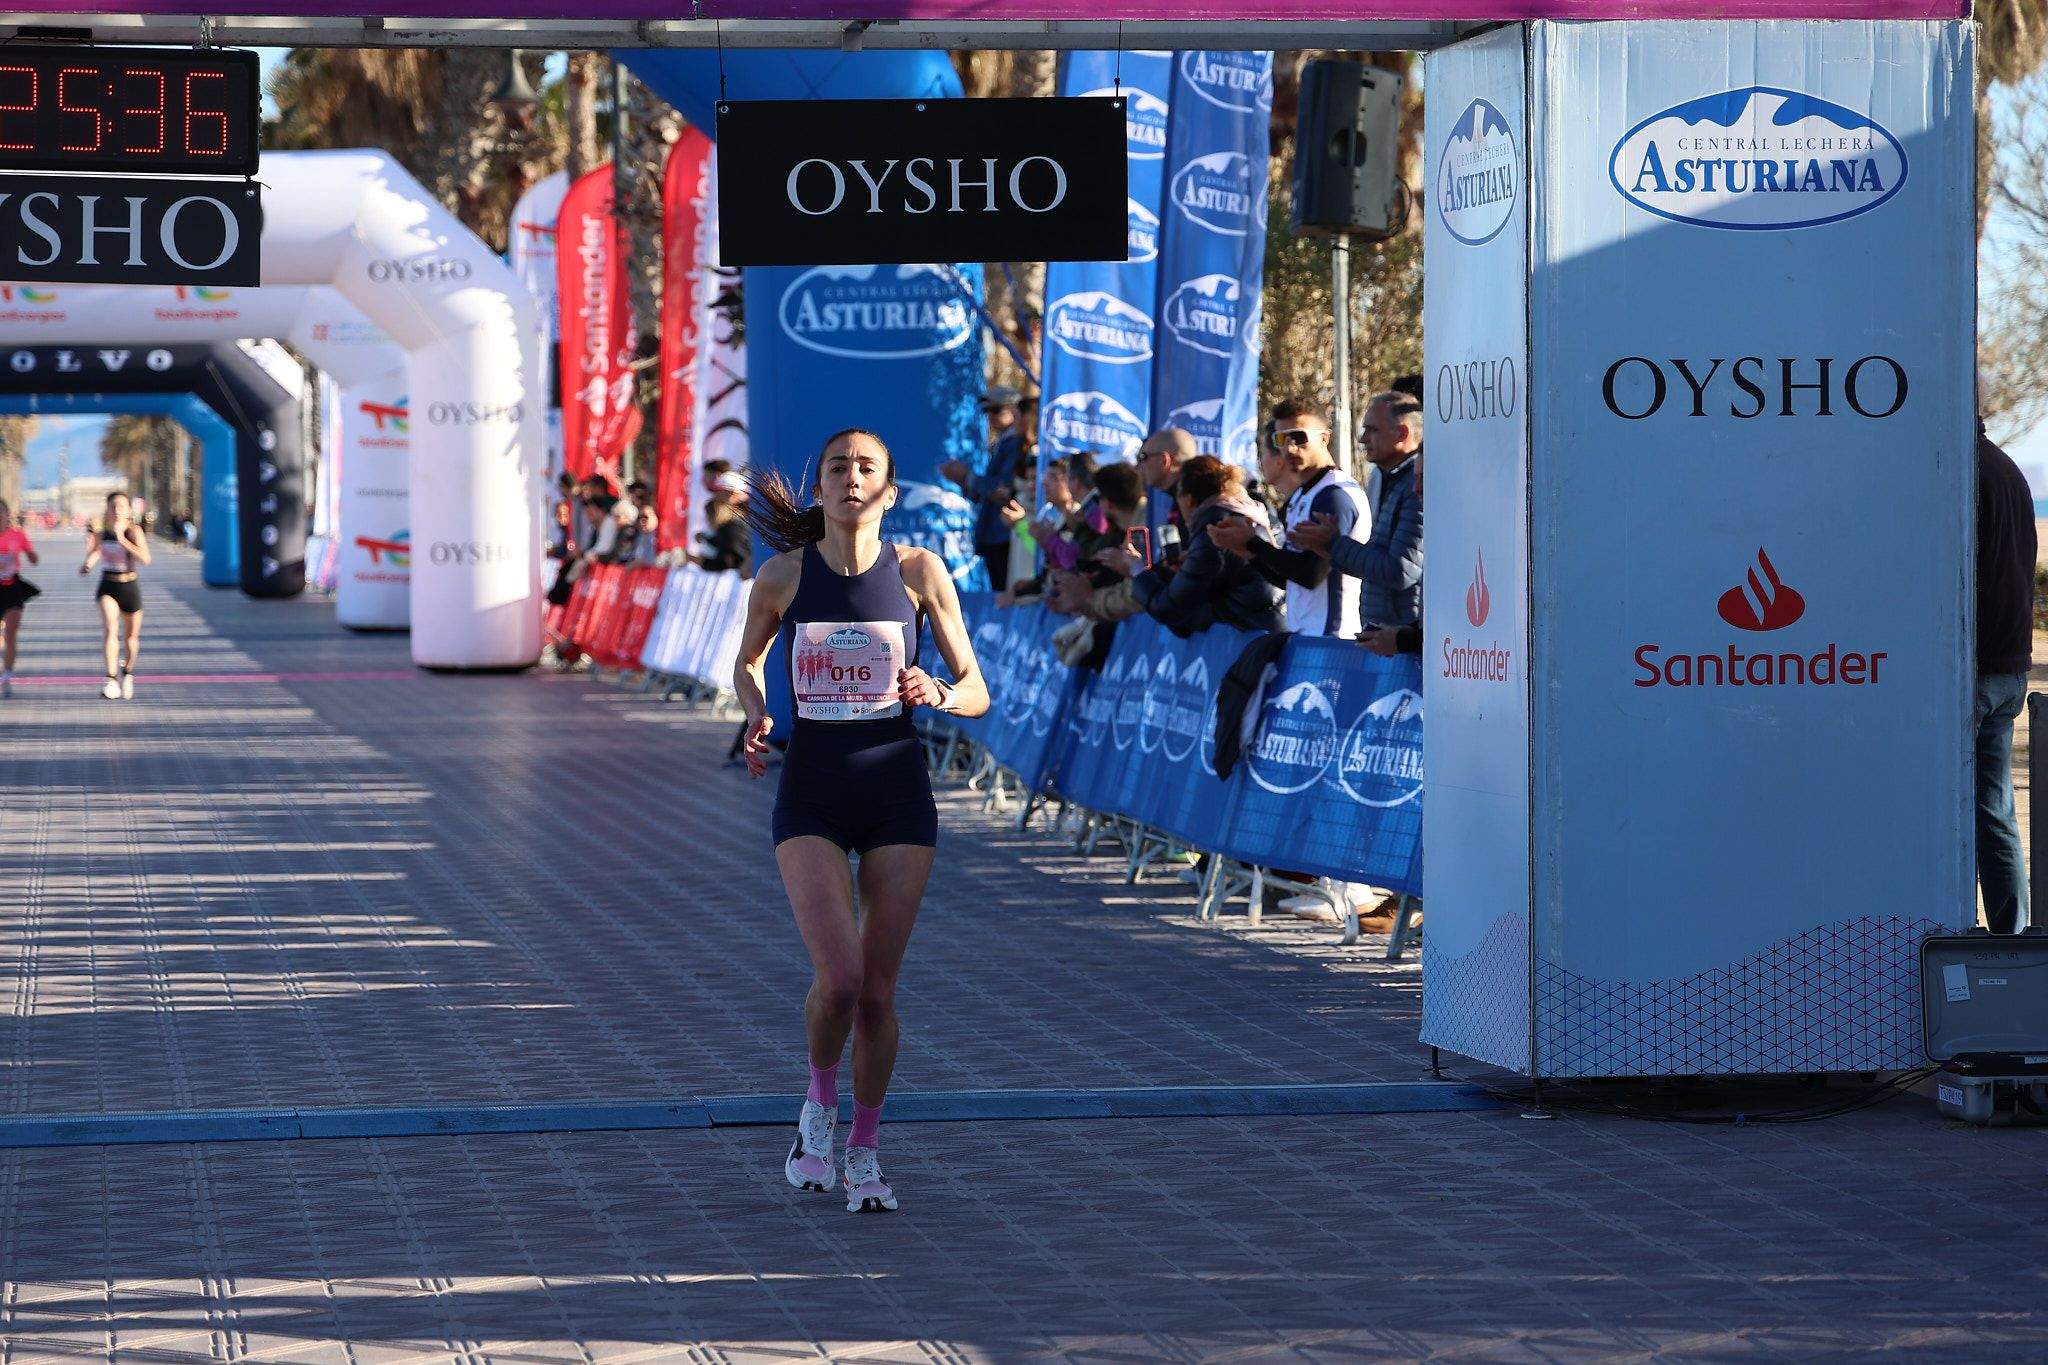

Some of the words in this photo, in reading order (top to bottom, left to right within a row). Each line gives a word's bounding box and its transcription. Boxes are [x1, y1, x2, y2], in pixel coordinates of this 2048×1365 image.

[1678, 137, 1770, 151] CENTRAL
[1781, 137, 1875, 151] LECHERA
[786, 156, 1068, 216] OYSHO
[1443, 160, 1513, 213] ASTURIANA
[1632, 140, 1885, 194] ASTURIANA
[0, 192, 240, 271] SHO
[368, 258, 472, 283] OYSHO
[1437, 356, 1516, 424] OYSHO
[1602, 355, 1909, 421] OYSHO
[829, 636, 868, 645] ASTURIANA
[1443, 637, 1511, 682] Santander
[831, 665, 871, 682] 016
[1633, 642, 1887, 688] Santander
[807, 706, 839, 715] OYSHO
[839, 685, 858, 693] 6830
